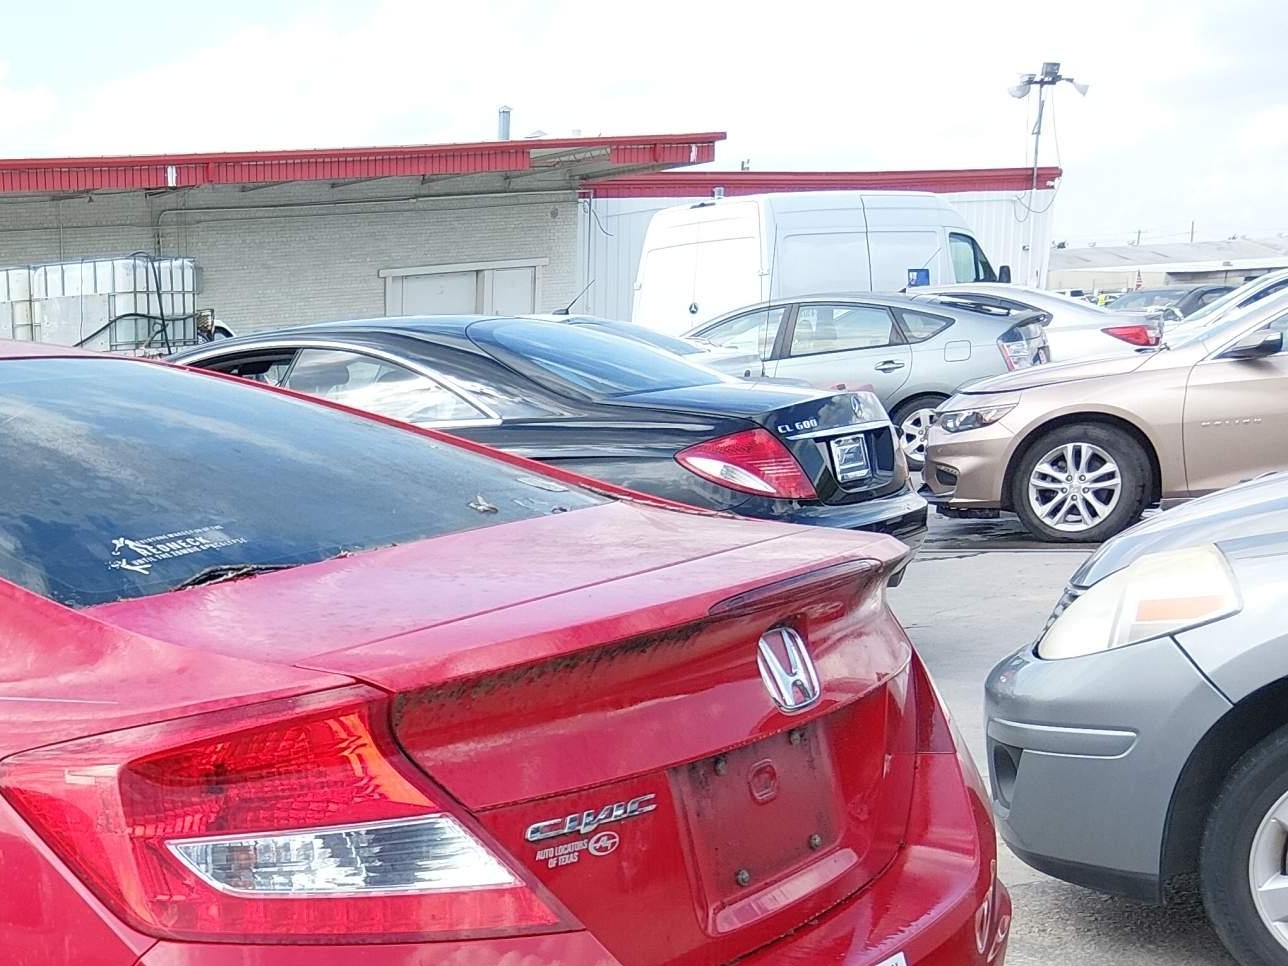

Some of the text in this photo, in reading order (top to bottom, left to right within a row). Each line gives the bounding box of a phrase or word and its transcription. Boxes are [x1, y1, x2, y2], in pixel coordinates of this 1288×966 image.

[777, 418, 818, 434] CL 600
[138, 536, 210, 557] REDNECK
[525, 793, 657, 842] CIVIC
[535, 848, 554, 861] AUTO
[554, 839, 589, 857] LOCATORS
[548, 852, 579, 869] OF TEXAS
